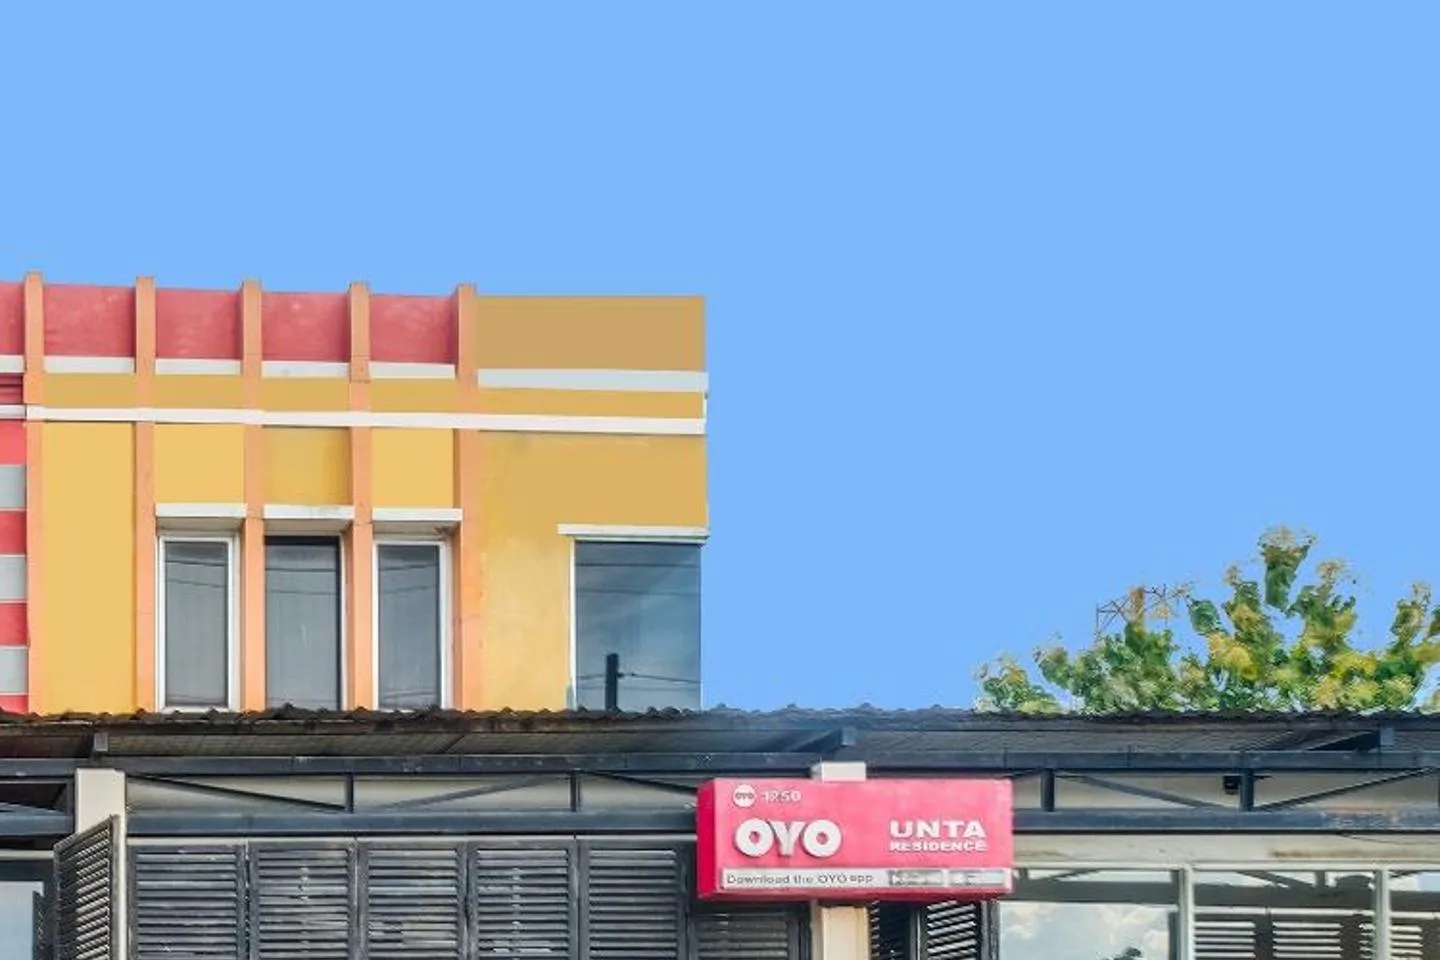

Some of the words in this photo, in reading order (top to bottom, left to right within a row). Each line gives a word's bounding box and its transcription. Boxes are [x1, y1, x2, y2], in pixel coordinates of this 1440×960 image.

[889, 820, 986, 838] UNTA
[735, 818, 842, 857] OYO
[889, 840, 987, 852] RESIDENCE
[726, 873, 789, 884] Download
[794, 873, 814, 884] the
[818, 874, 847, 883] OYO
[850, 874, 873, 884] app
